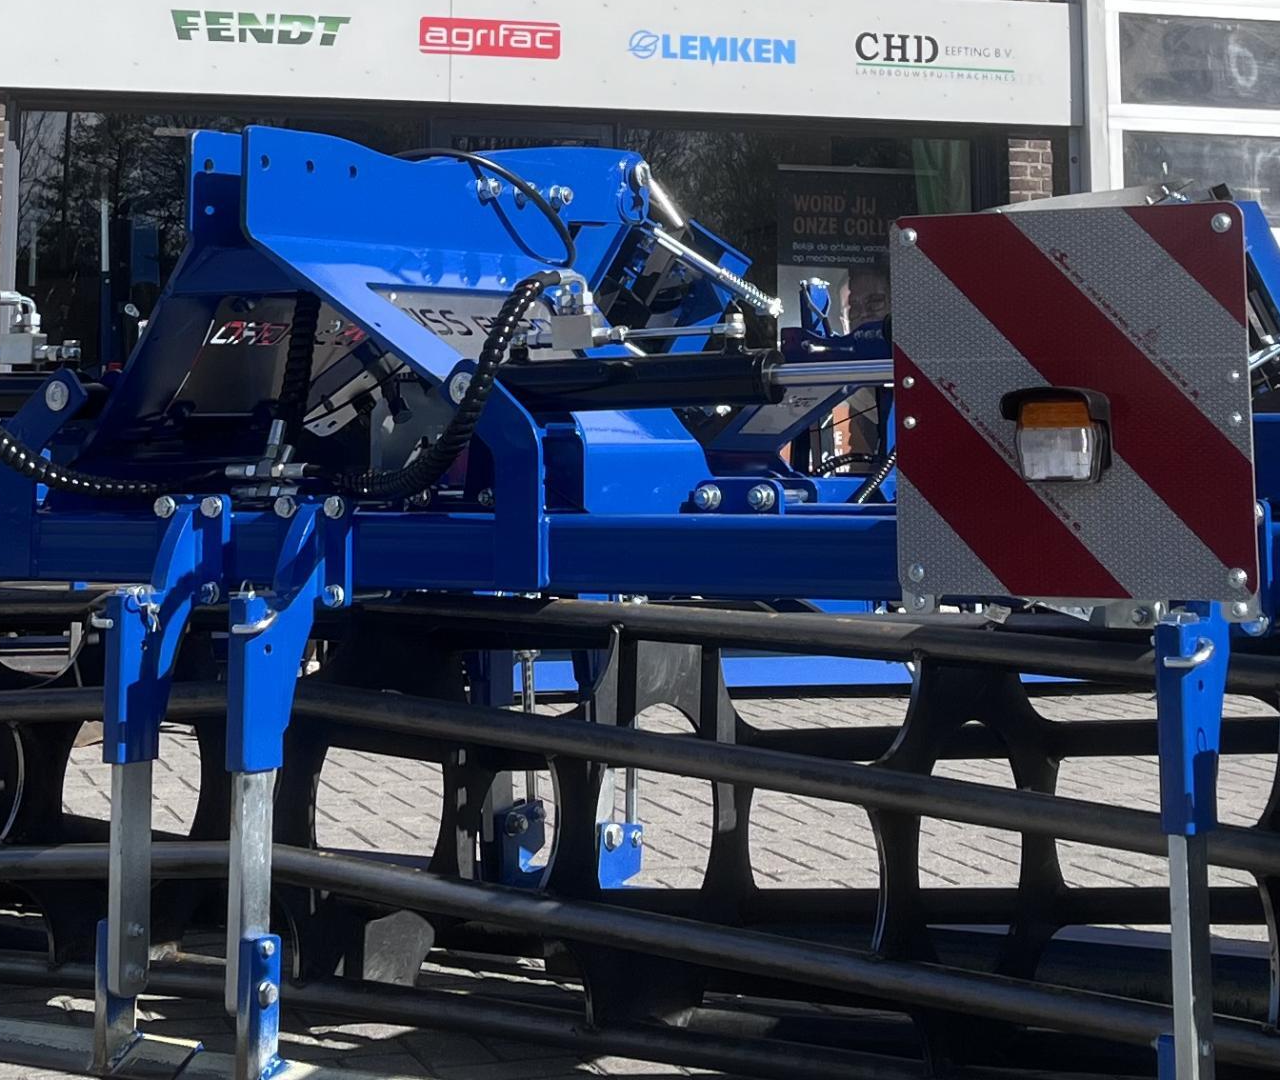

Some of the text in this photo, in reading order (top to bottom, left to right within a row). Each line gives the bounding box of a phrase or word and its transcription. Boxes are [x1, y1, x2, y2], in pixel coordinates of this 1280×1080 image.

[170, 8, 352, 47] FENDT
[422, 21, 557, 54] agrifac
[661, 33, 797, 66] LEMKEN
[854, 31, 939, 63] CHD
[944, 45, 991, 58] EEFTING
[793, 194, 846, 213] WORD
[792, 215, 839, 235] ONZE
